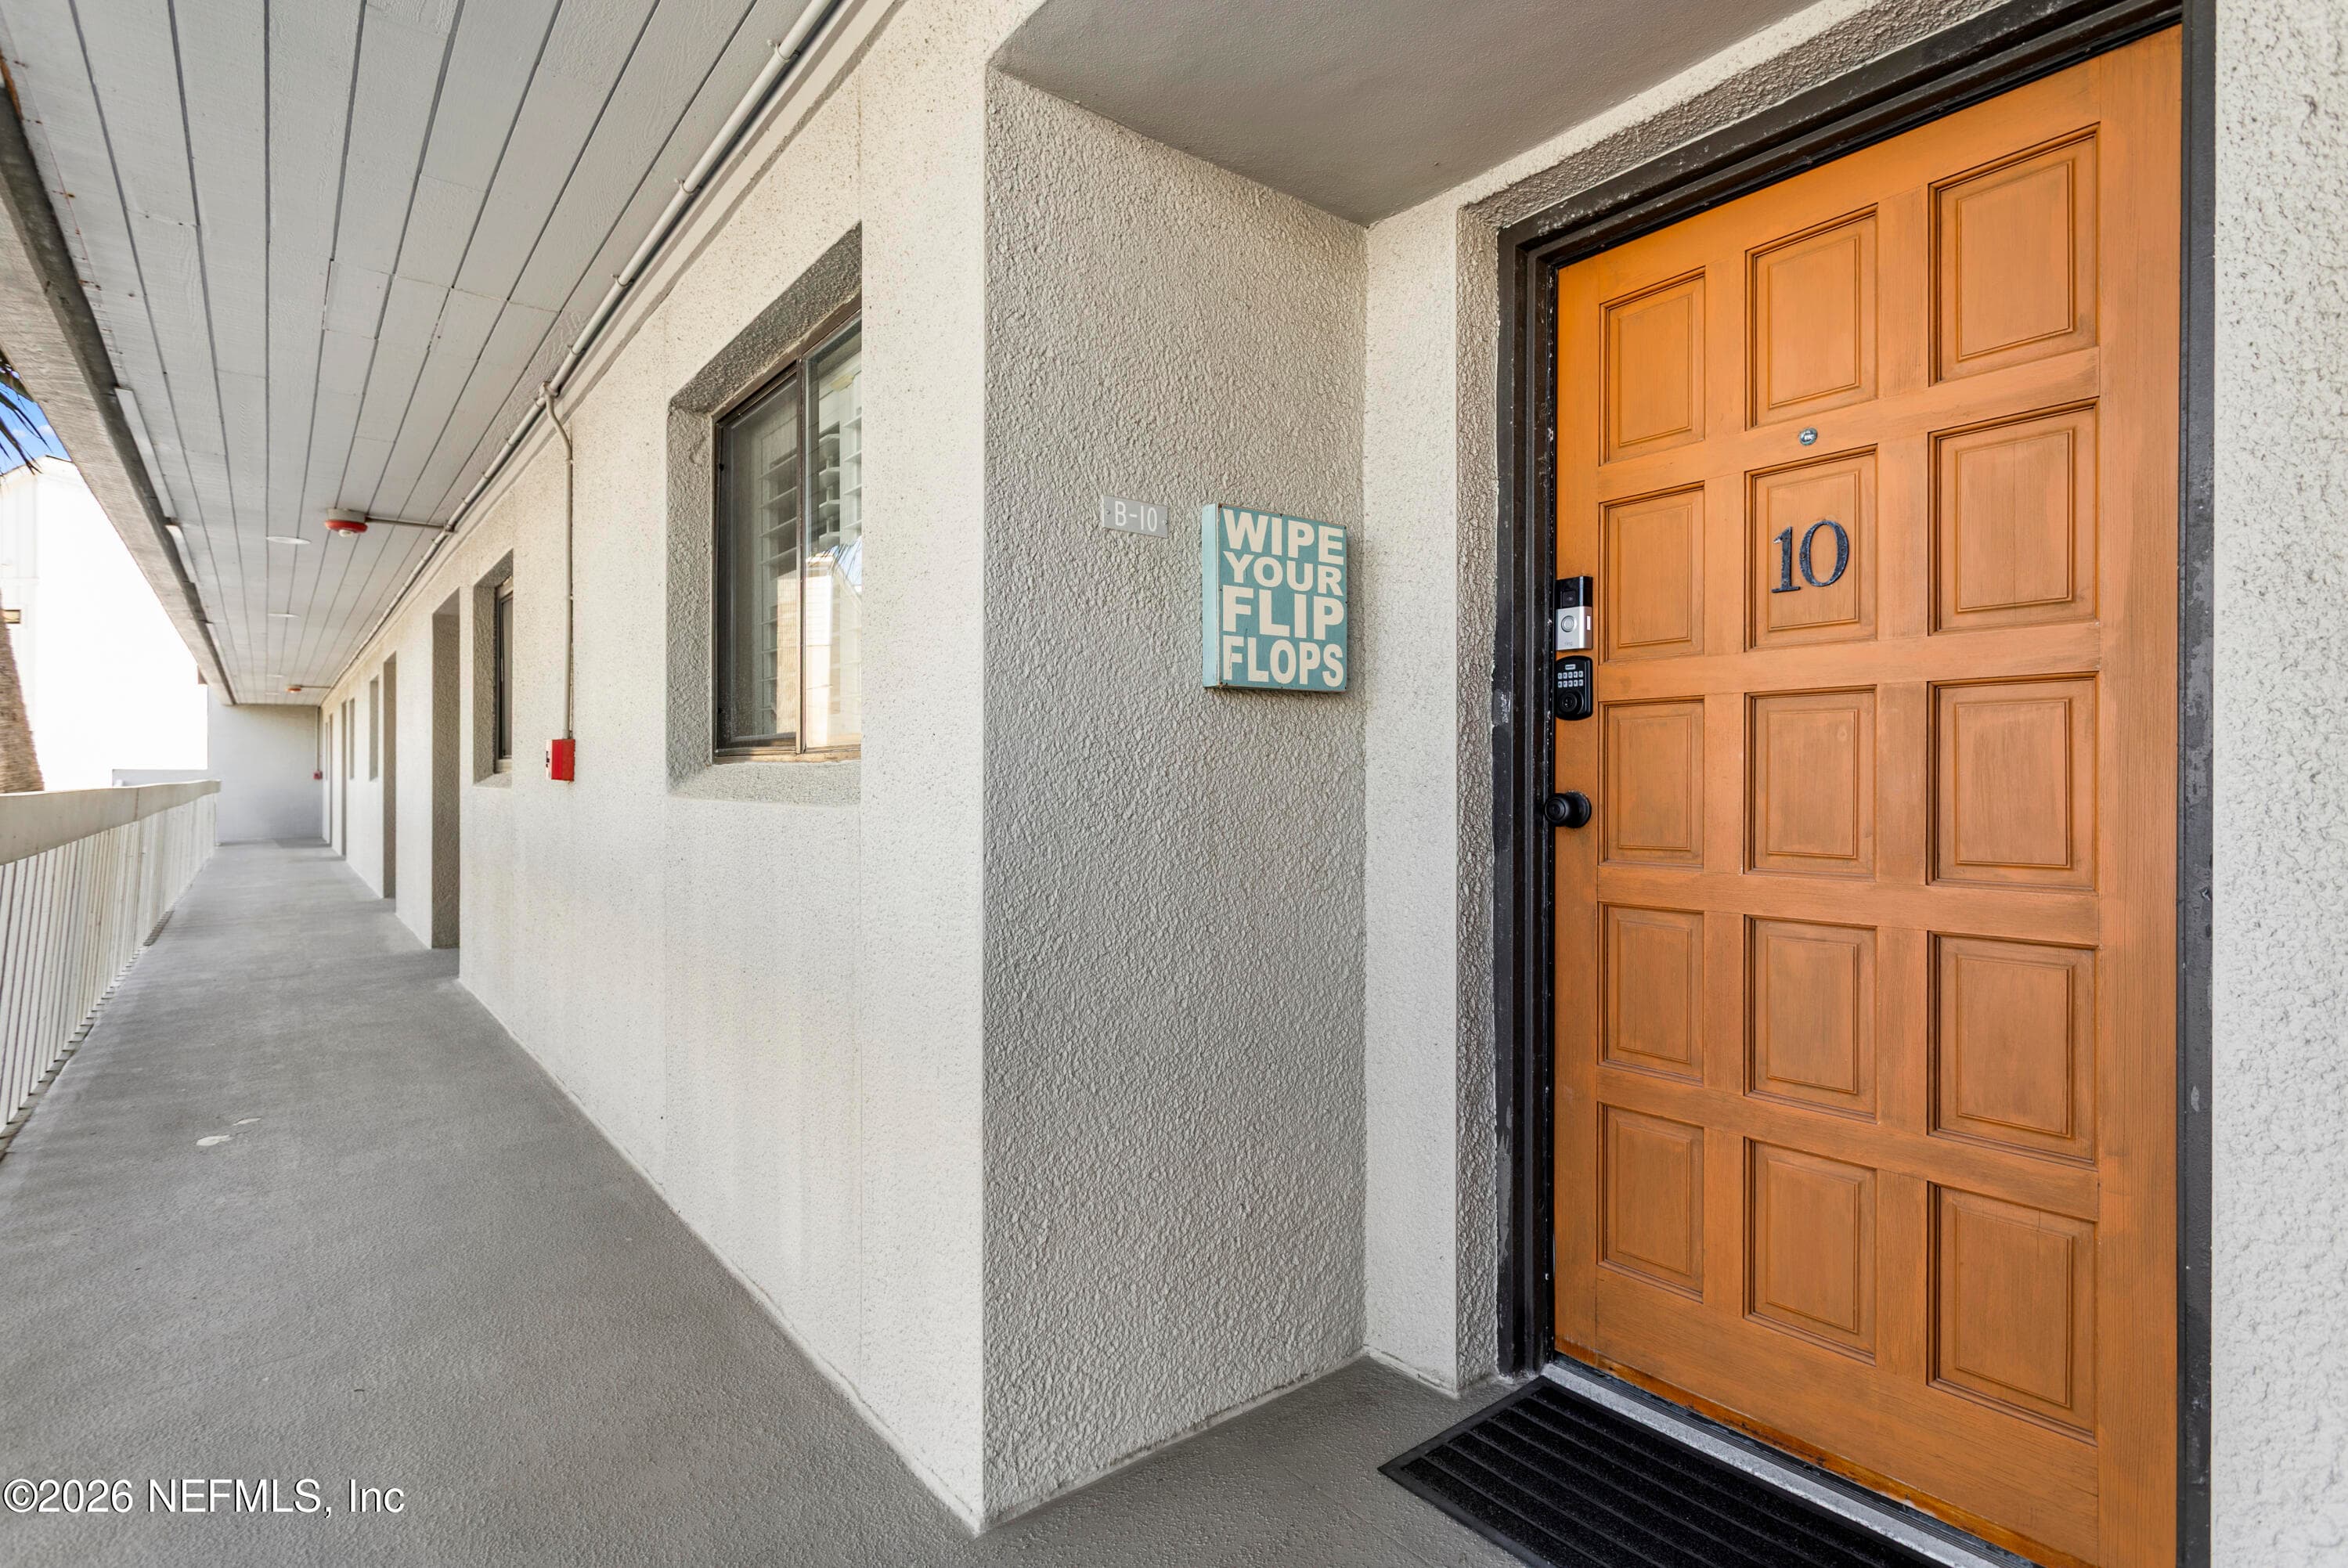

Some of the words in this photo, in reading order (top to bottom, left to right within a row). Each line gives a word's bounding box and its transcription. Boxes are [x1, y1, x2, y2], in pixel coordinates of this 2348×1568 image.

[1114, 500, 1158, 532] B-10
[1223, 509, 1344, 565] WIPE
[1223, 551, 1344, 597] YOUR
[1771, 520, 1849, 593] 10
[1222, 585, 1344, 640] FLIP
[1222, 635, 1344, 687] FLOPS
